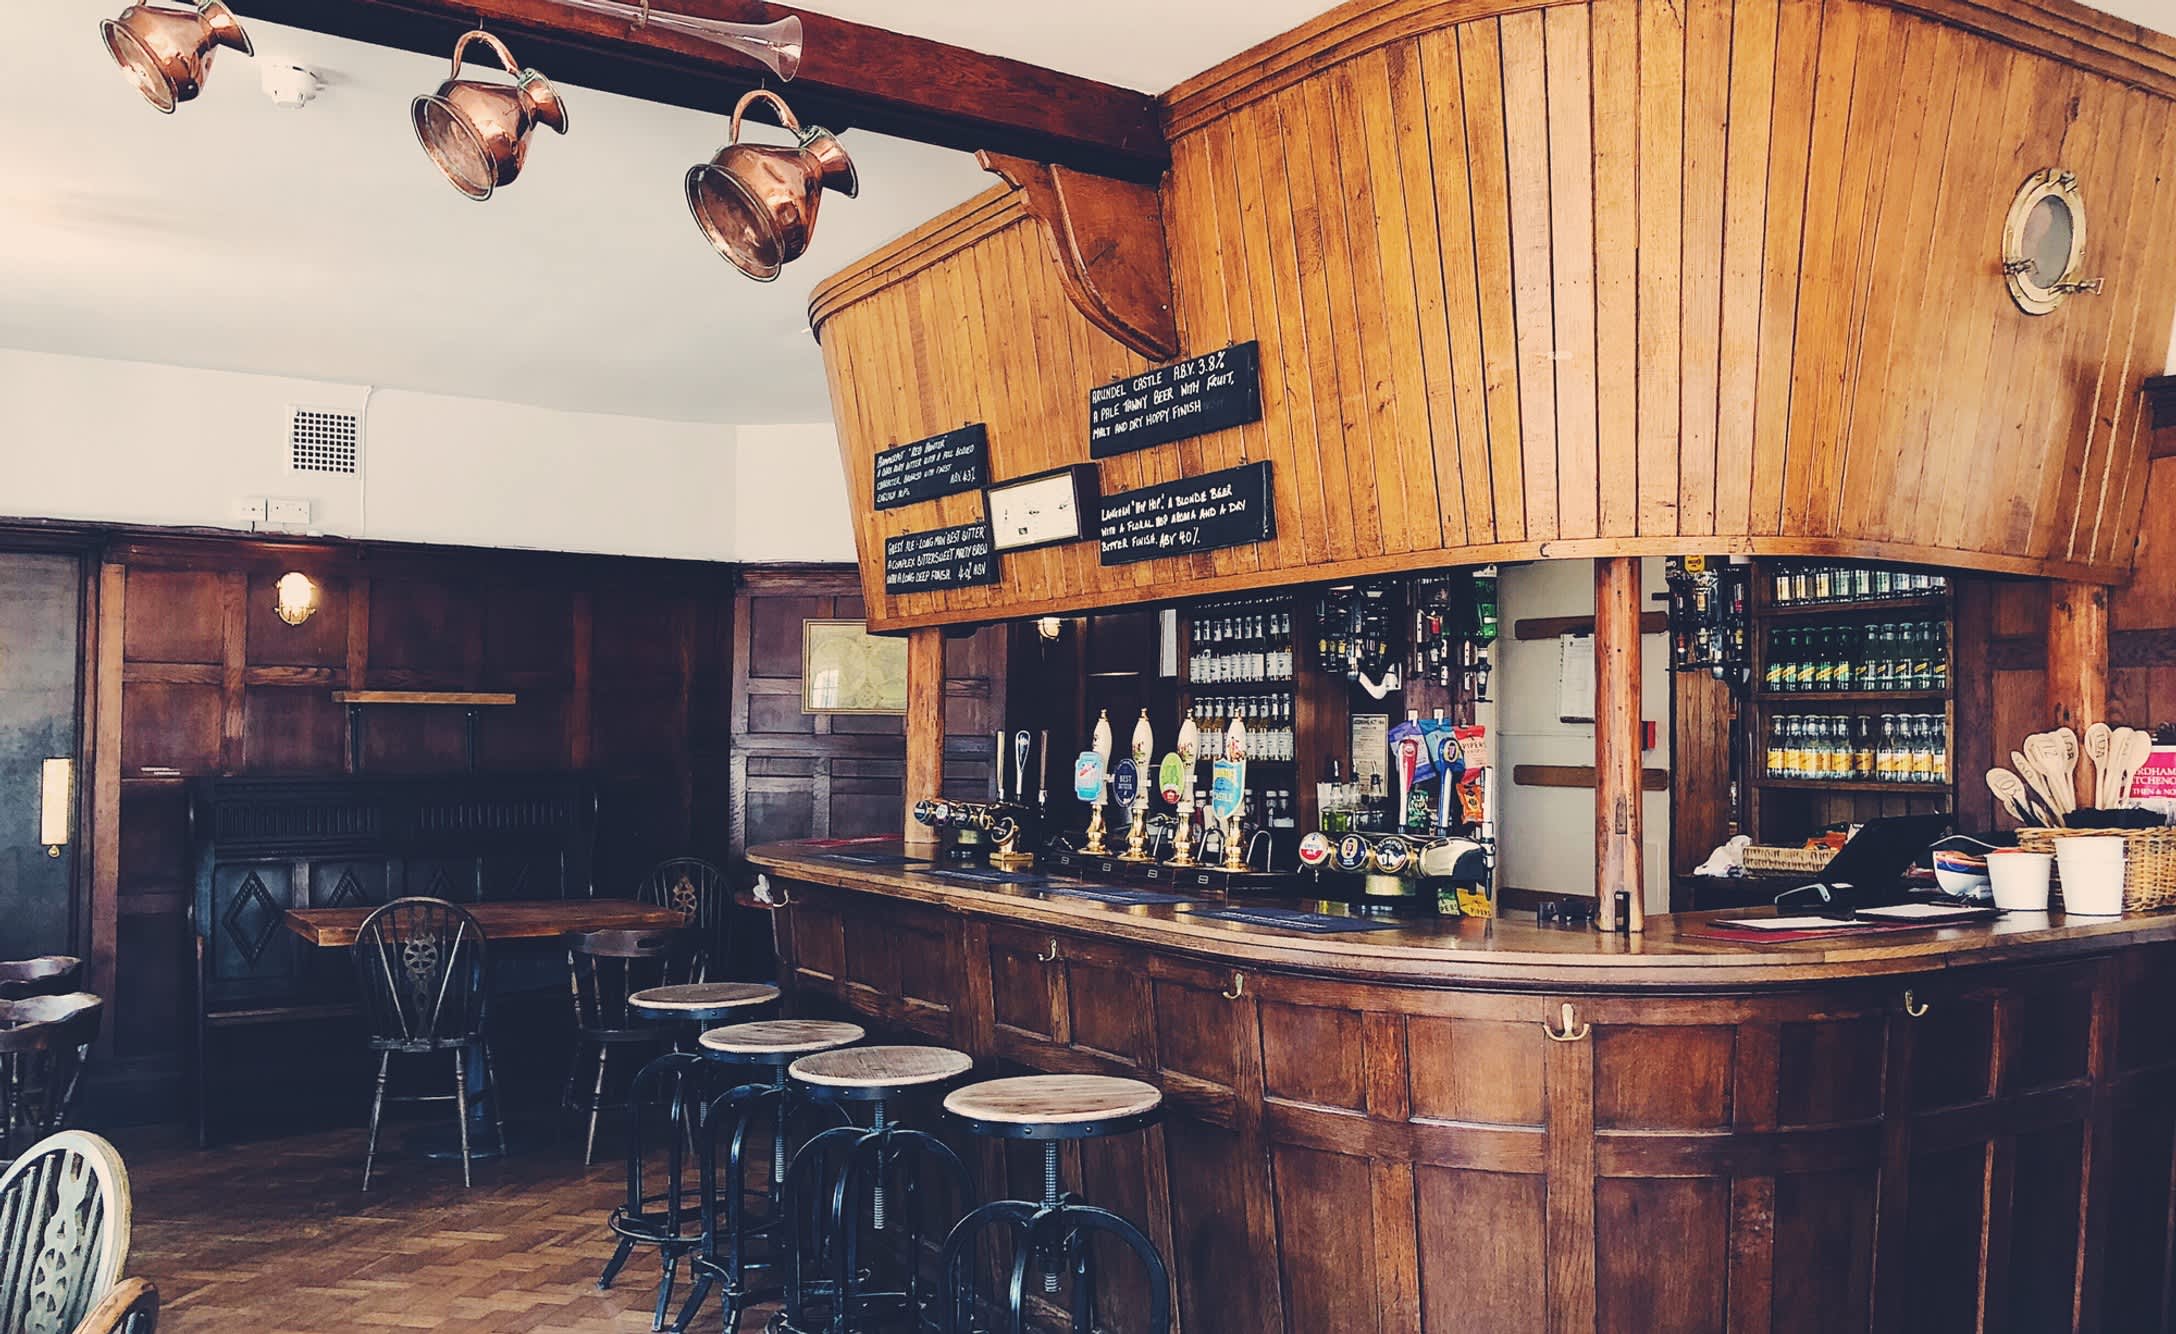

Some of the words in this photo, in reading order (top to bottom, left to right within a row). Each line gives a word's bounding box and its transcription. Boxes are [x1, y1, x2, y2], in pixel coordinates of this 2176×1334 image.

[1092, 385, 1126, 404] ARUNDEL
[1133, 371, 1162, 391] CASTLE
[1198, 351, 1226, 375] 3.8%
[1093, 411, 1099, 424] A
[1100, 404, 1120, 421] PALE
[1122, 394, 1149, 413] TAWNY
[1153, 387, 1175, 405] BEER
[1180, 380, 1200, 397] WITH
[1206, 370, 1235, 391] FRUIT,
[1092, 426, 1111, 440] MALT
[1114, 421, 1128, 435] AND
[1129, 416, 1144, 432] DRY
[1145, 407, 1171, 426] HOPPY
[1172, 399, 1202, 420] FINISH
[1167, 497, 1173, 509] A
[1175, 491, 1208, 506] BLONDE
[1209, 484, 1233, 501] BEER
[1101, 525, 1116, 537] WITH
[1119, 522, 1126, 534] A
[1127, 518, 1154, 532] FLORAL
[1155, 514, 1169, 528] HOP
[1171, 509, 1197, 524] AROMA
[1199, 506, 1217, 520] AND
[1219, 503, 1226, 516] A
[1229, 499, 1246, 513] DRY
[887, 540, 904, 556] GUEST
[905, 539, 915, 553] ALE
[1101, 538, 1129, 552] BITTER
[1159, 531, 1177, 549] ABV
[892, 558, 916, 570] COMPLEX
[916, 547, 956, 566] BITTERSWEET
[971, 543, 988, 557] BREW
[901, 572, 915, 584] LONG
[915, 570, 931, 582] DEEP
[973, 562, 986, 576] ABV
[1119, 775, 1132, 783] BEST
[2135, 776, 2176, 785] TCHENO
[2138, 767, 2176, 776] RDHAM
[2163, 788, 2176, 796] NO
